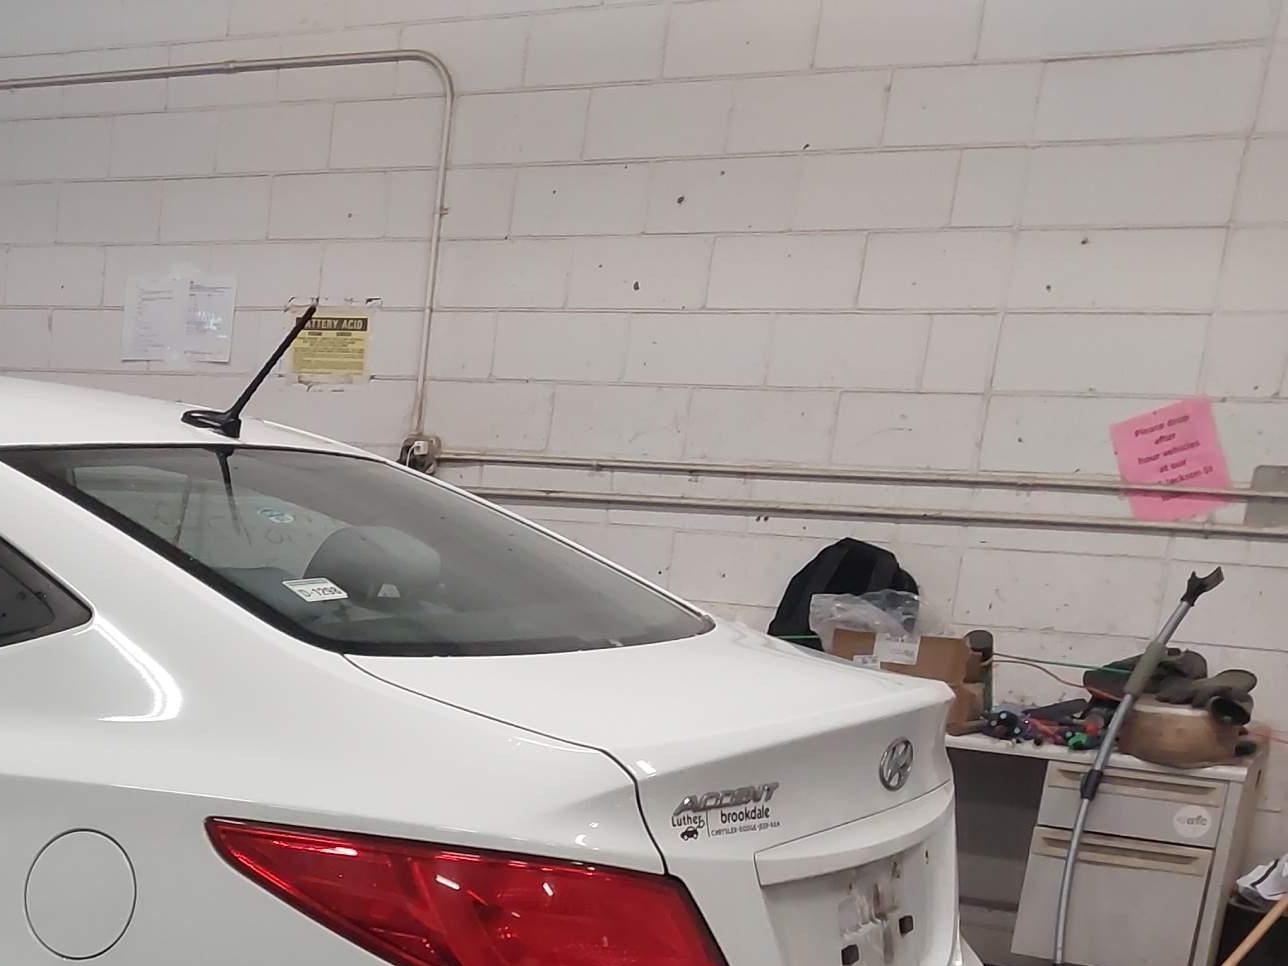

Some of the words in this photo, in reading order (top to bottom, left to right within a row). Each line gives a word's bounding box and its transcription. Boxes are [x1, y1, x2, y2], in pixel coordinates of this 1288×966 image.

[299, 319, 339, 330] ATTERY
[341, 319, 364, 330] ACID
[1134, 423, 1165, 437] Please
[1167, 415, 1190, 427] drop
[1154, 433, 1176, 445] after
[1137, 454, 1160, 465] hour
[1162, 440, 1201, 457] vehicles
[673, 781, 780, 816] ACCENT
[671, 815, 703, 827] Luther
[720, 804, 771, 824] brookdale
